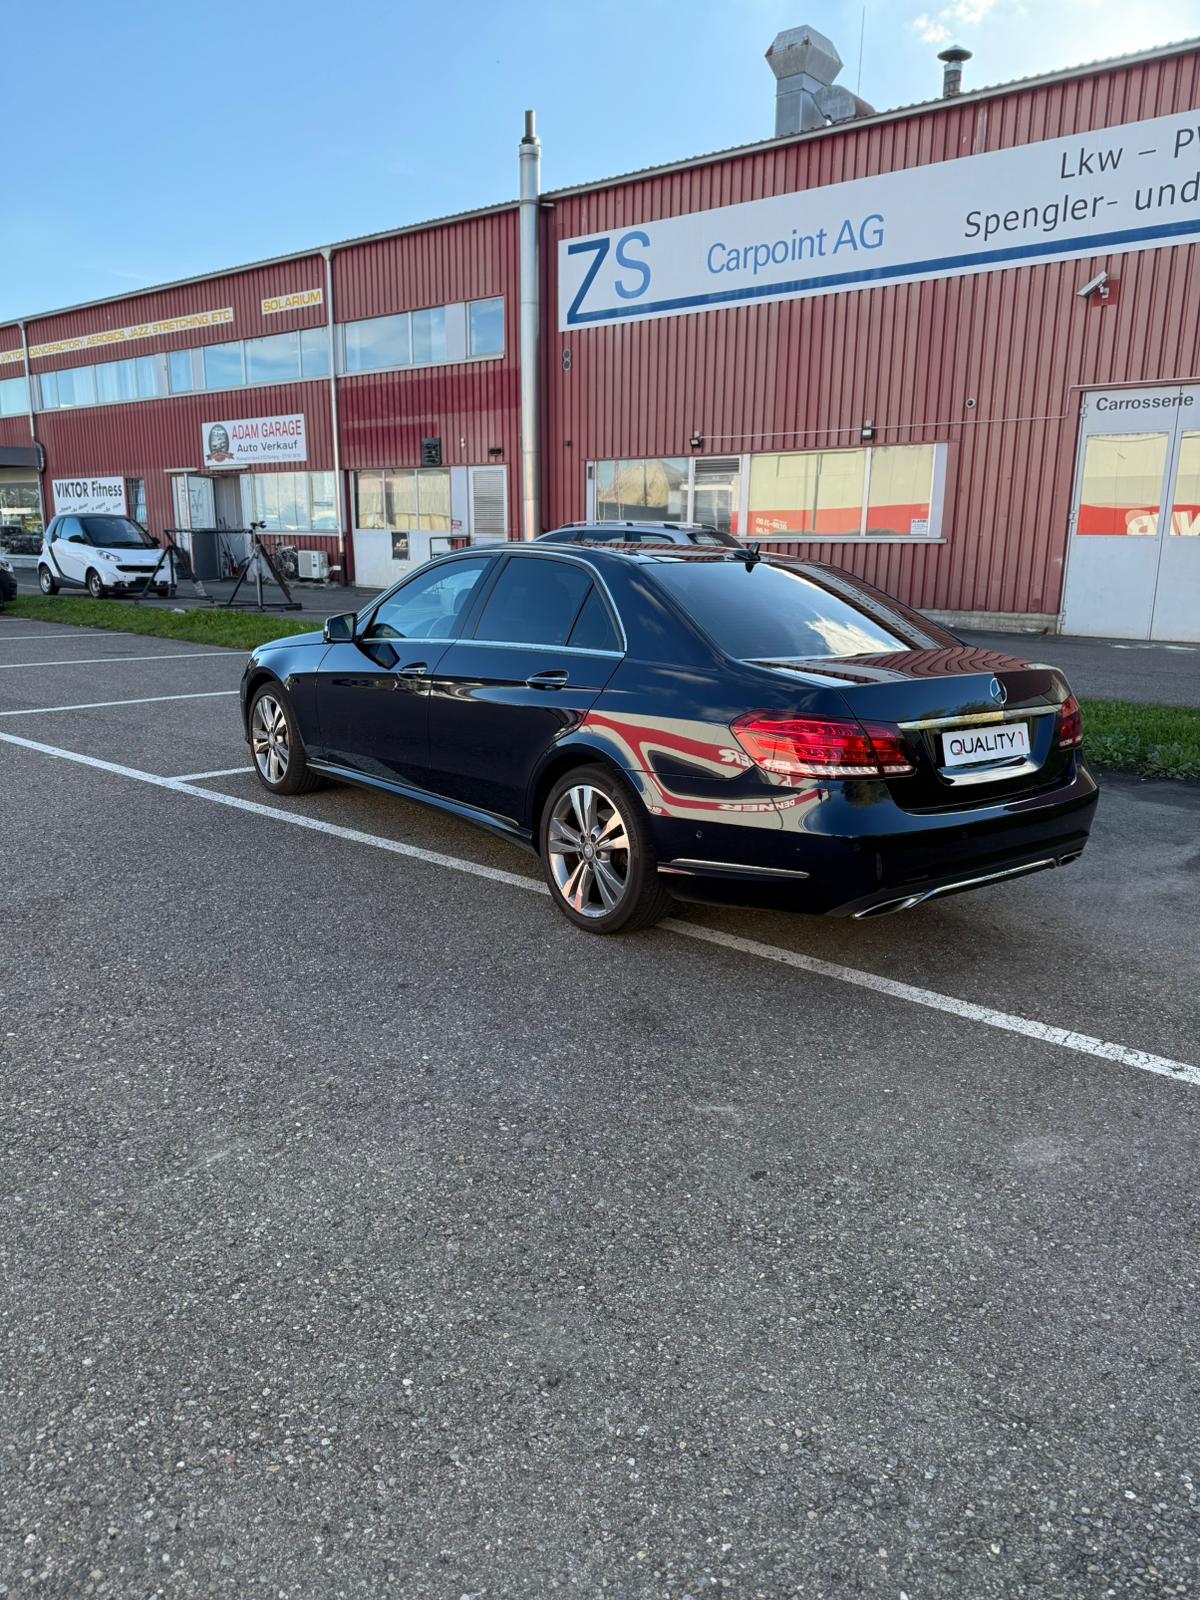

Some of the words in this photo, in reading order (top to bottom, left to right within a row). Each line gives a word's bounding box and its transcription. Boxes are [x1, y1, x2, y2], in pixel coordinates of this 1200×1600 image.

[1060, 147, 1124, 180] Lkw
[1174, 125, 1200, 159] P
[964, 194, 1119, 242] Spengler-
[1134, 171, 1200, 211] und
[706, 228, 828, 275] Carpoint
[832, 213, 885, 254] AG
[567, 230, 652, 325] ZS
[263, 291, 321, 312] SOLARIUM
[1095, 392, 1194, 412] Carrosserie
[231, 423, 259, 440] ADAM
[261, 419, 302, 438] GARAGE
[237, 443, 258, 453] Auto
[260, 440, 298, 452] Verkauf
[54, 481, 89, 498] VIKTOR
[91, 480, 122, 497] Fitness
[949, 731, 1016, 756] QUALITY
